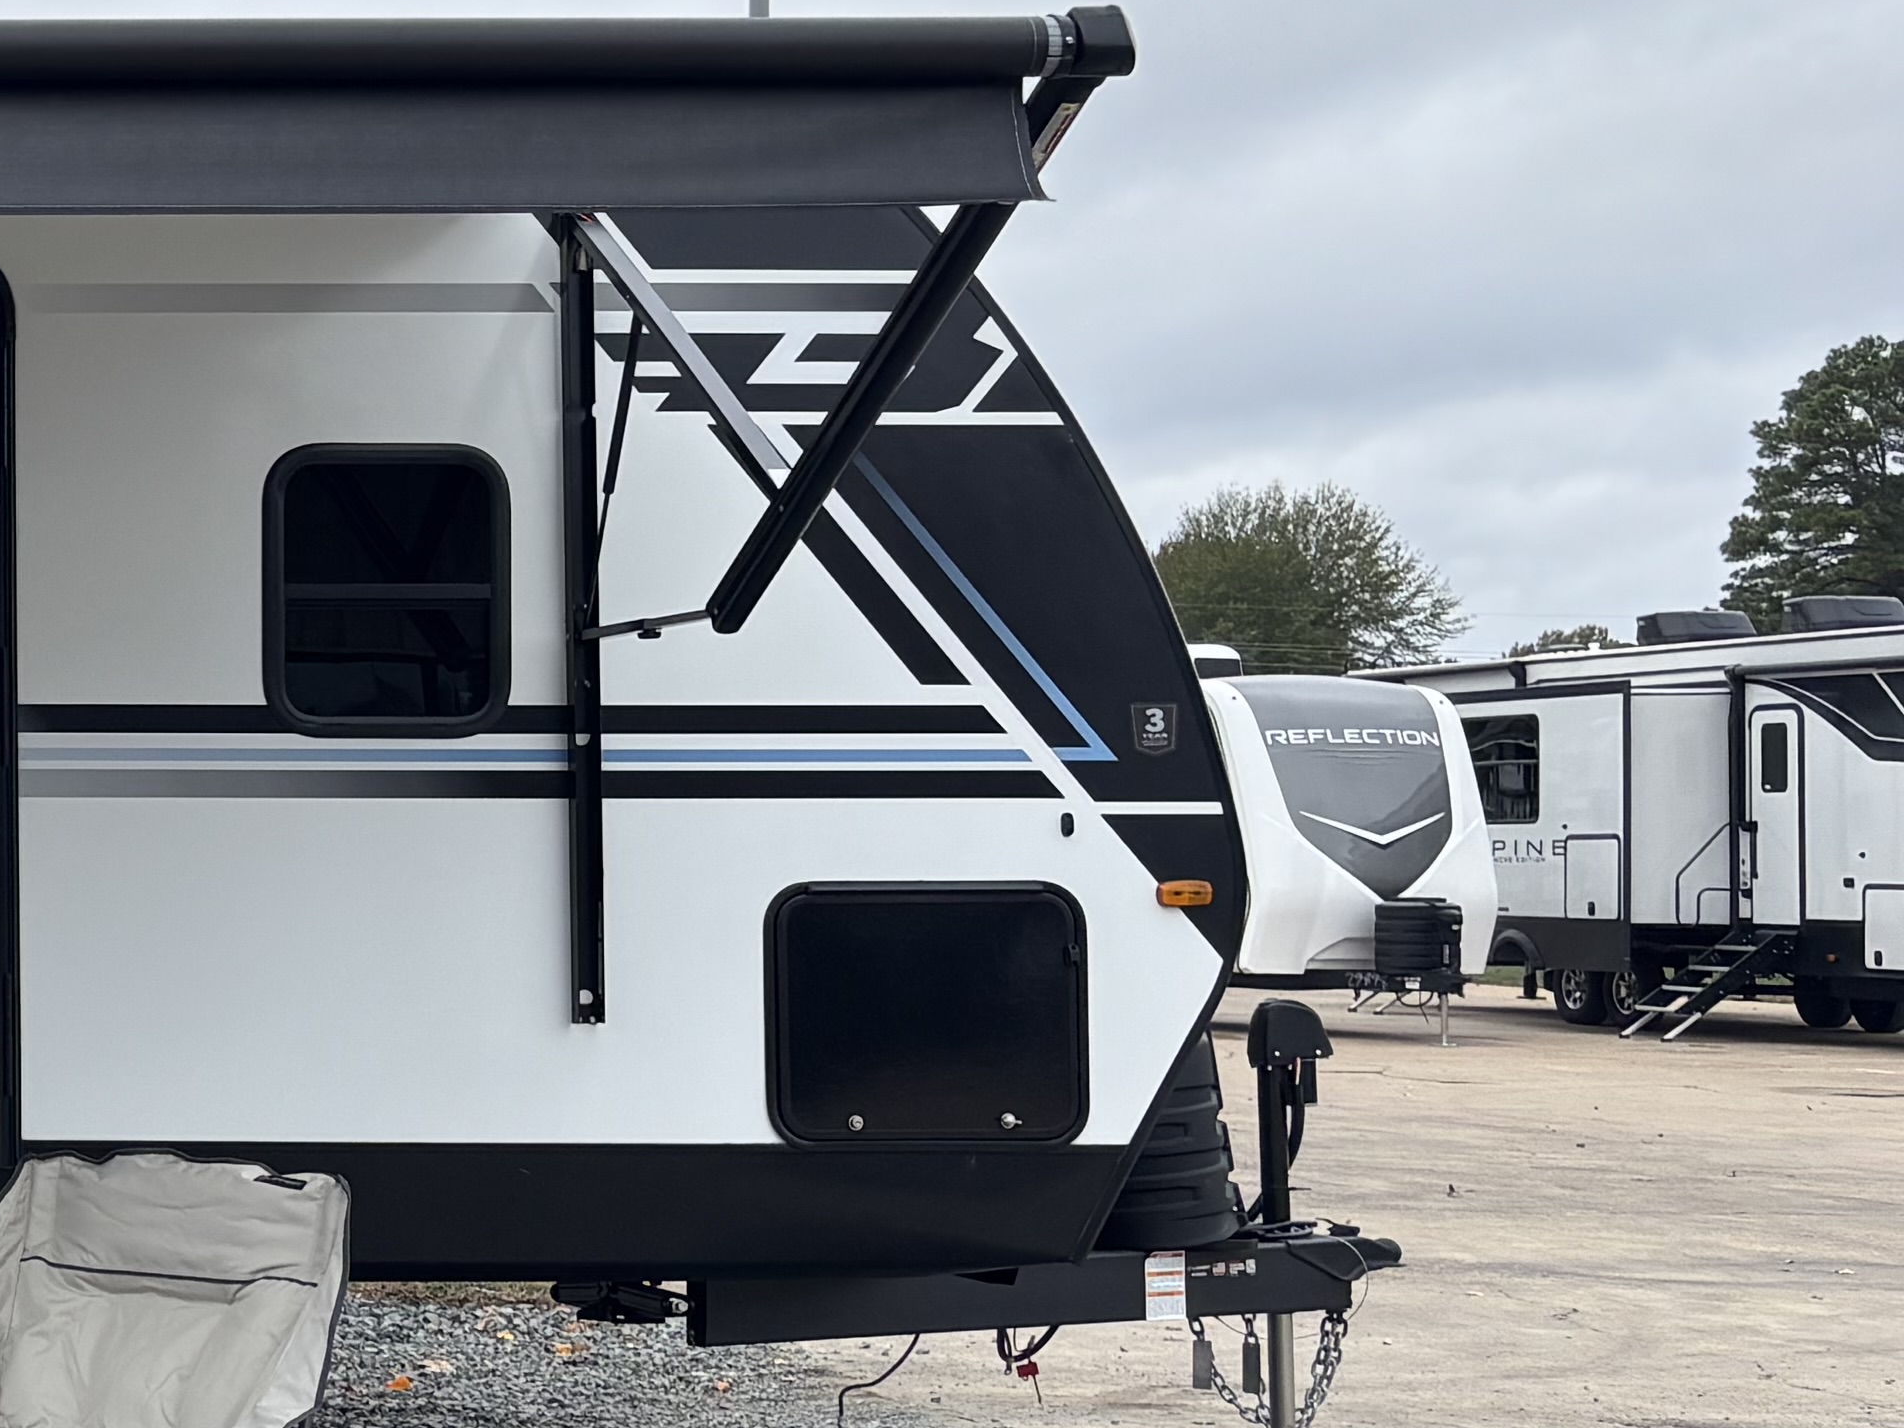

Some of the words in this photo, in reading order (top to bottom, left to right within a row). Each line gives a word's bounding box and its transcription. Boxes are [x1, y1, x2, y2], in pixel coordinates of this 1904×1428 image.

[1144, 707, 1165, 733] 3
[1264, 728, 1440, 746] REFLECTION
[1492, 839, 1567, 857] PINE
